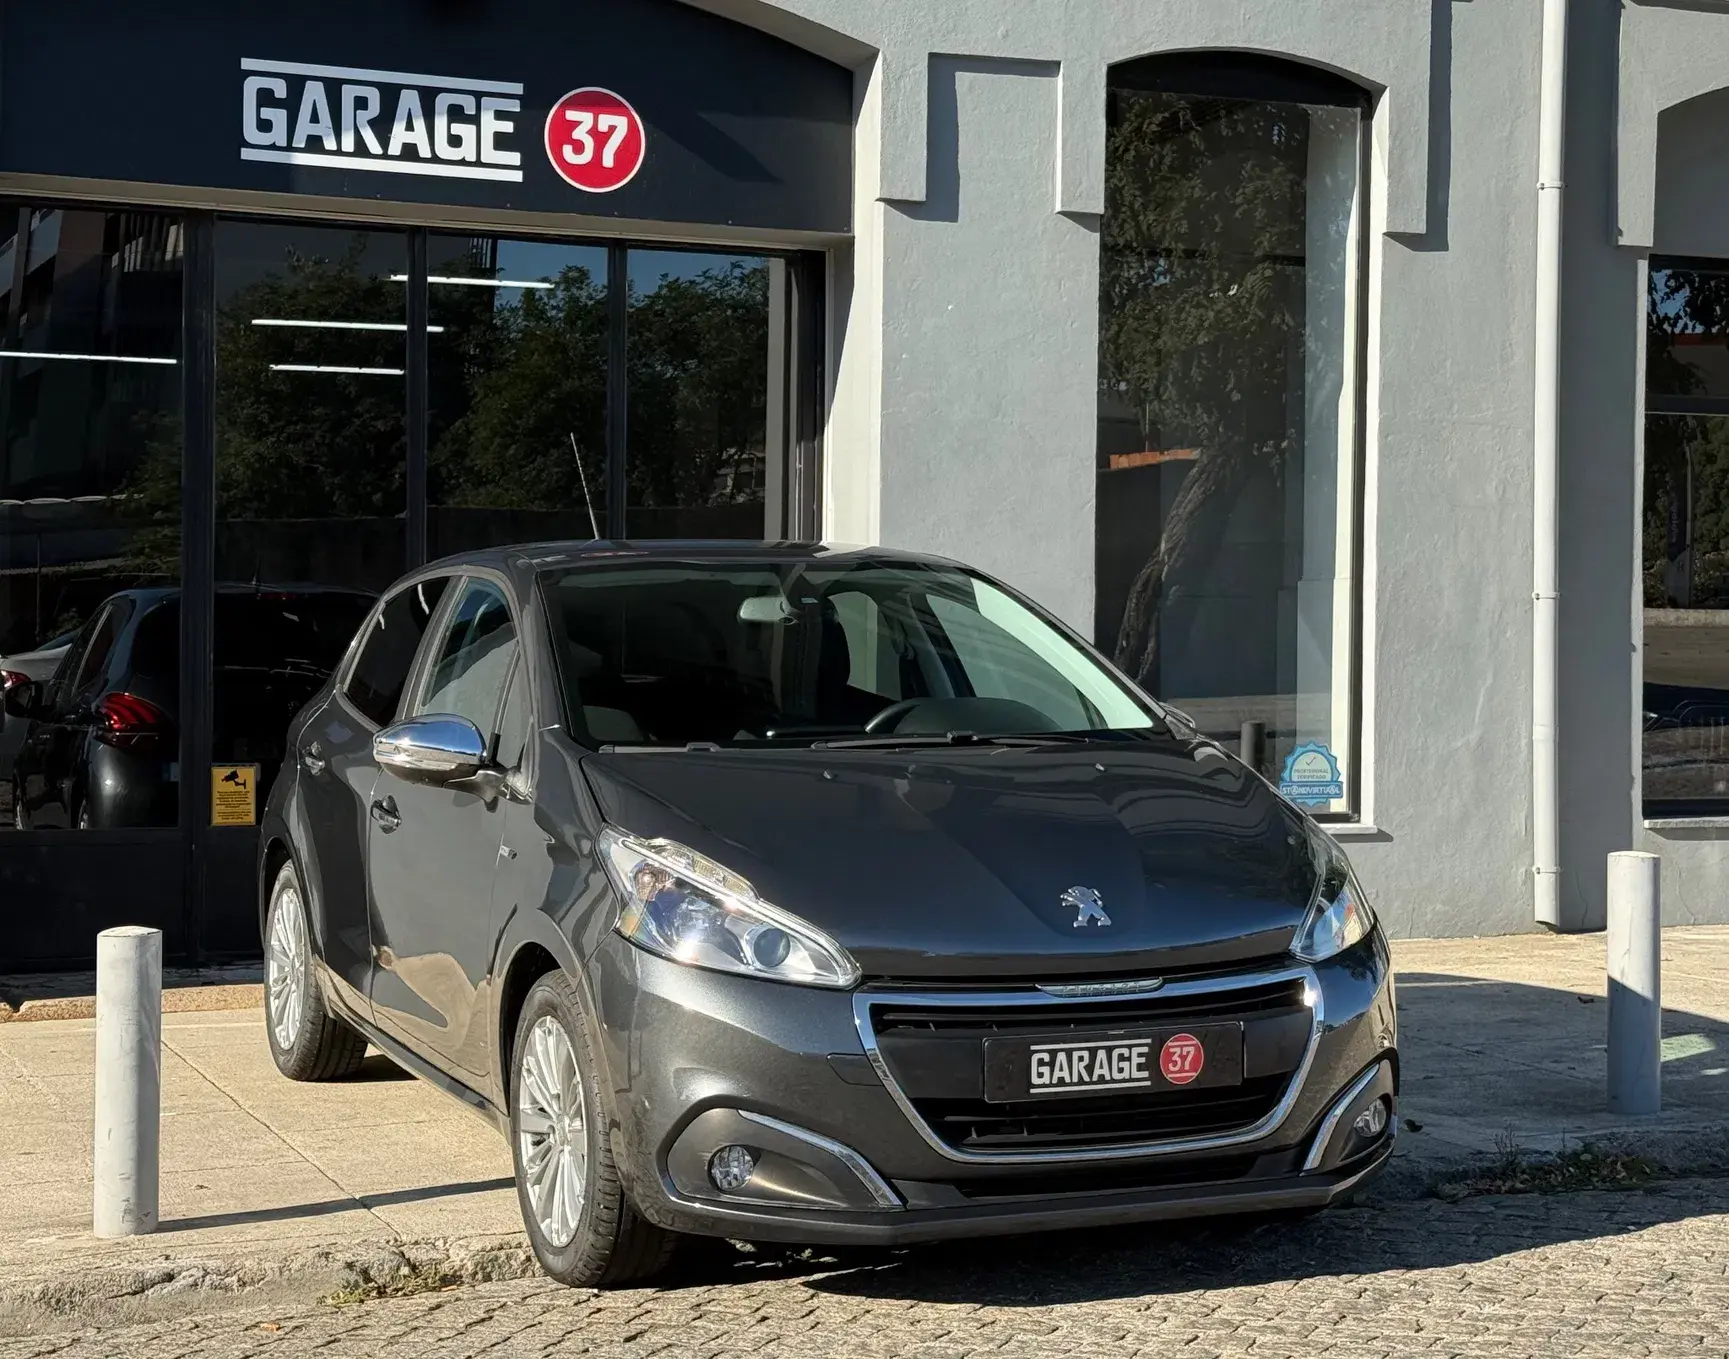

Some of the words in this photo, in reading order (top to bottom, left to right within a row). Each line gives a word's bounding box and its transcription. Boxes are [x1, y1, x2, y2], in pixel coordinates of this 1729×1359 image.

[243, 75, 521, 166] GARAGE
[562, 110, 628, 168] 37
[1031, 1046, 1149, 1085] GARAGE
[1168, 1046, 1195, 1071] 37
